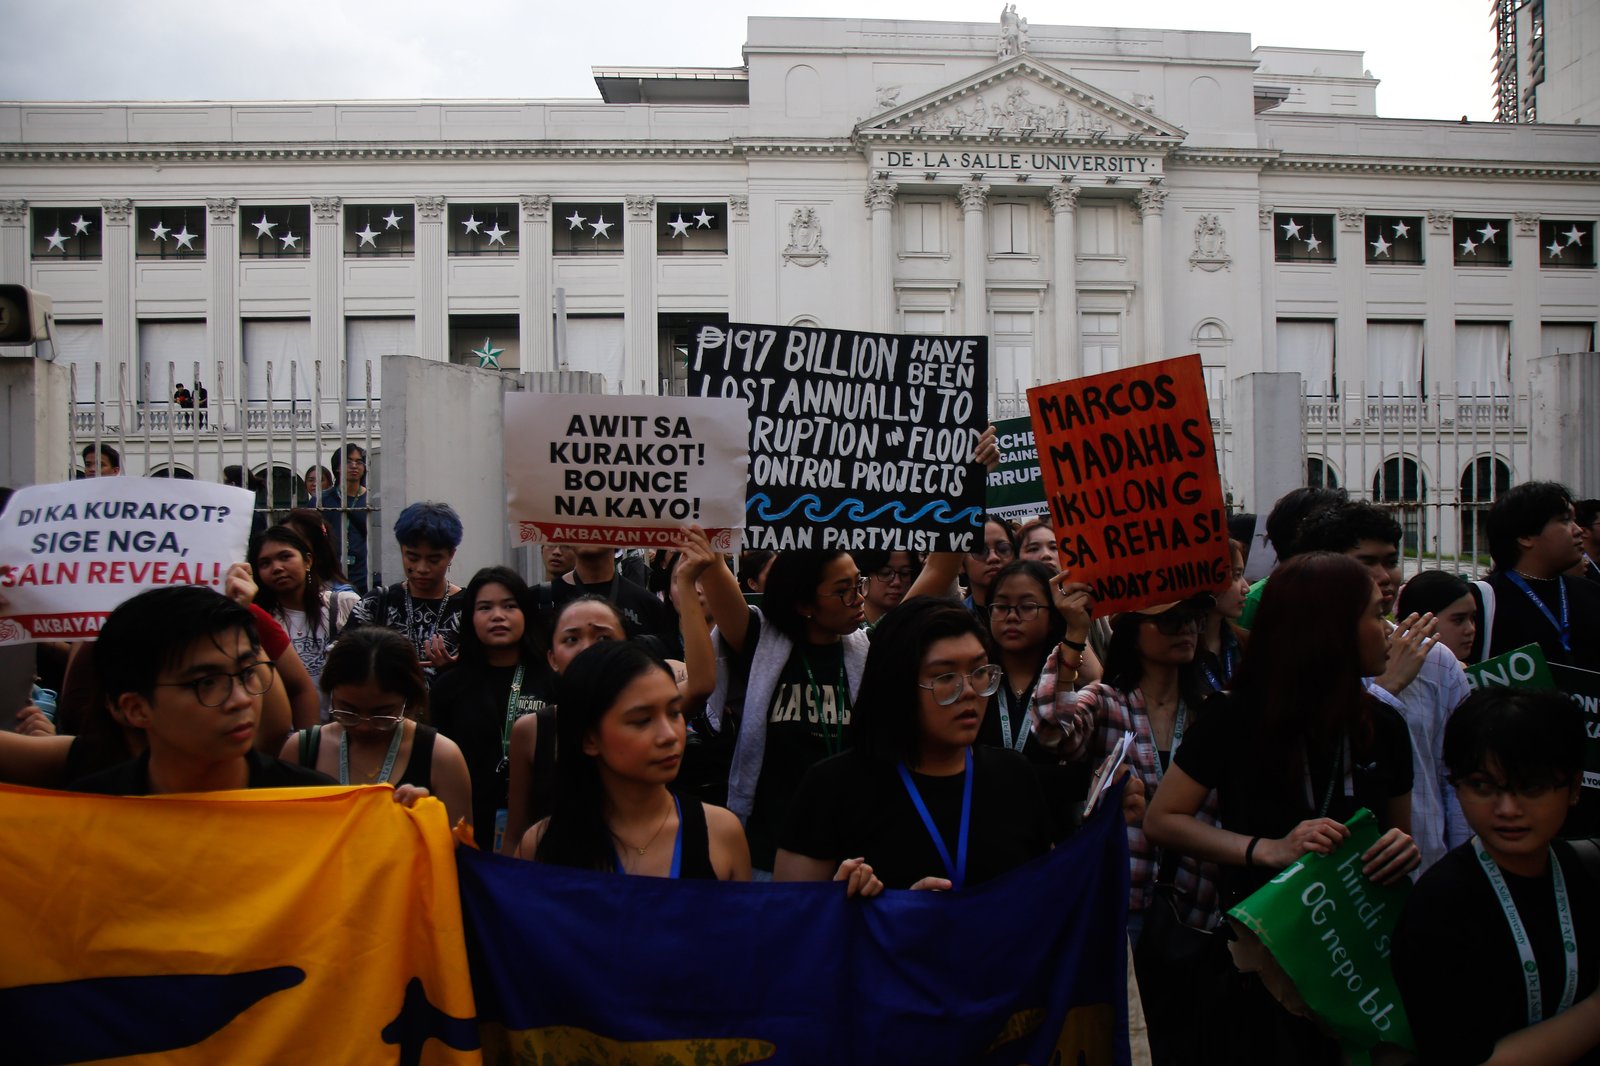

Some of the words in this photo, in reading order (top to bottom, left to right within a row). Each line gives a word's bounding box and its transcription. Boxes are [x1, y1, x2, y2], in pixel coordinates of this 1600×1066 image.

[887, 152, 914, 167] DE
[924, 152, 950, 168] LA
[960, 153, 1022, 169] SALLE
[1032, 154, 1148, 173] UNIVERSITY
[783, 330, 899, 382] BILLION
[910, 338, 978, 364] HAVE
[907, 362, 975, 389] BEEN
[779, 377, 925, 424] ANNUALLY
[937, 388, 973, 425] TO
[1037, 374, 1176, 435] MARCOS
[566, 414, 648, 438] AWIT
[654, 416, 692, 438] SA
[747, 415, 880, 459] RUPTION
[886, 426, 904, 447] IN
[907, 426, 982, 464] FLOOD
[550, 441, 705, 466] KURAKOT!
[1049, 418, 1206, 487] MADAHAS
[564, 469, 688, 493] BOUNCE
[747, 454, 846, 489] ONTROL
[851, 460, 966, 497] PROJECTS
[986, 466, 1042, 487] RRUP
[555, 495, 598, 517] NA
[605, 497, 700, 520] KAYO!
[1052, 471, 1202, 527] IKULONG
[18, 507, 42, 526] DI
[44, 503, 78, 522] KA
[84, 501, 231, 523] KURAKOT?
[1001, 508, 1028, 518] YOUTH
[32, 530, 101, 554] SIGE
[108, 530, 189, 557] NGA,
[552, 527, 641, 543] AKBAYAN
[823, 526, 940, 552] PARTYLIST
[950, 530, 973, 552] VC
[1060, 534, 1097, 568] SA
[1103, 509, 1222, 560] REHAS!
[2, 561, 80, 588] SALN
[87, 561, 221, 586] REVEAL!
[768, 682, 801, 723] LA
